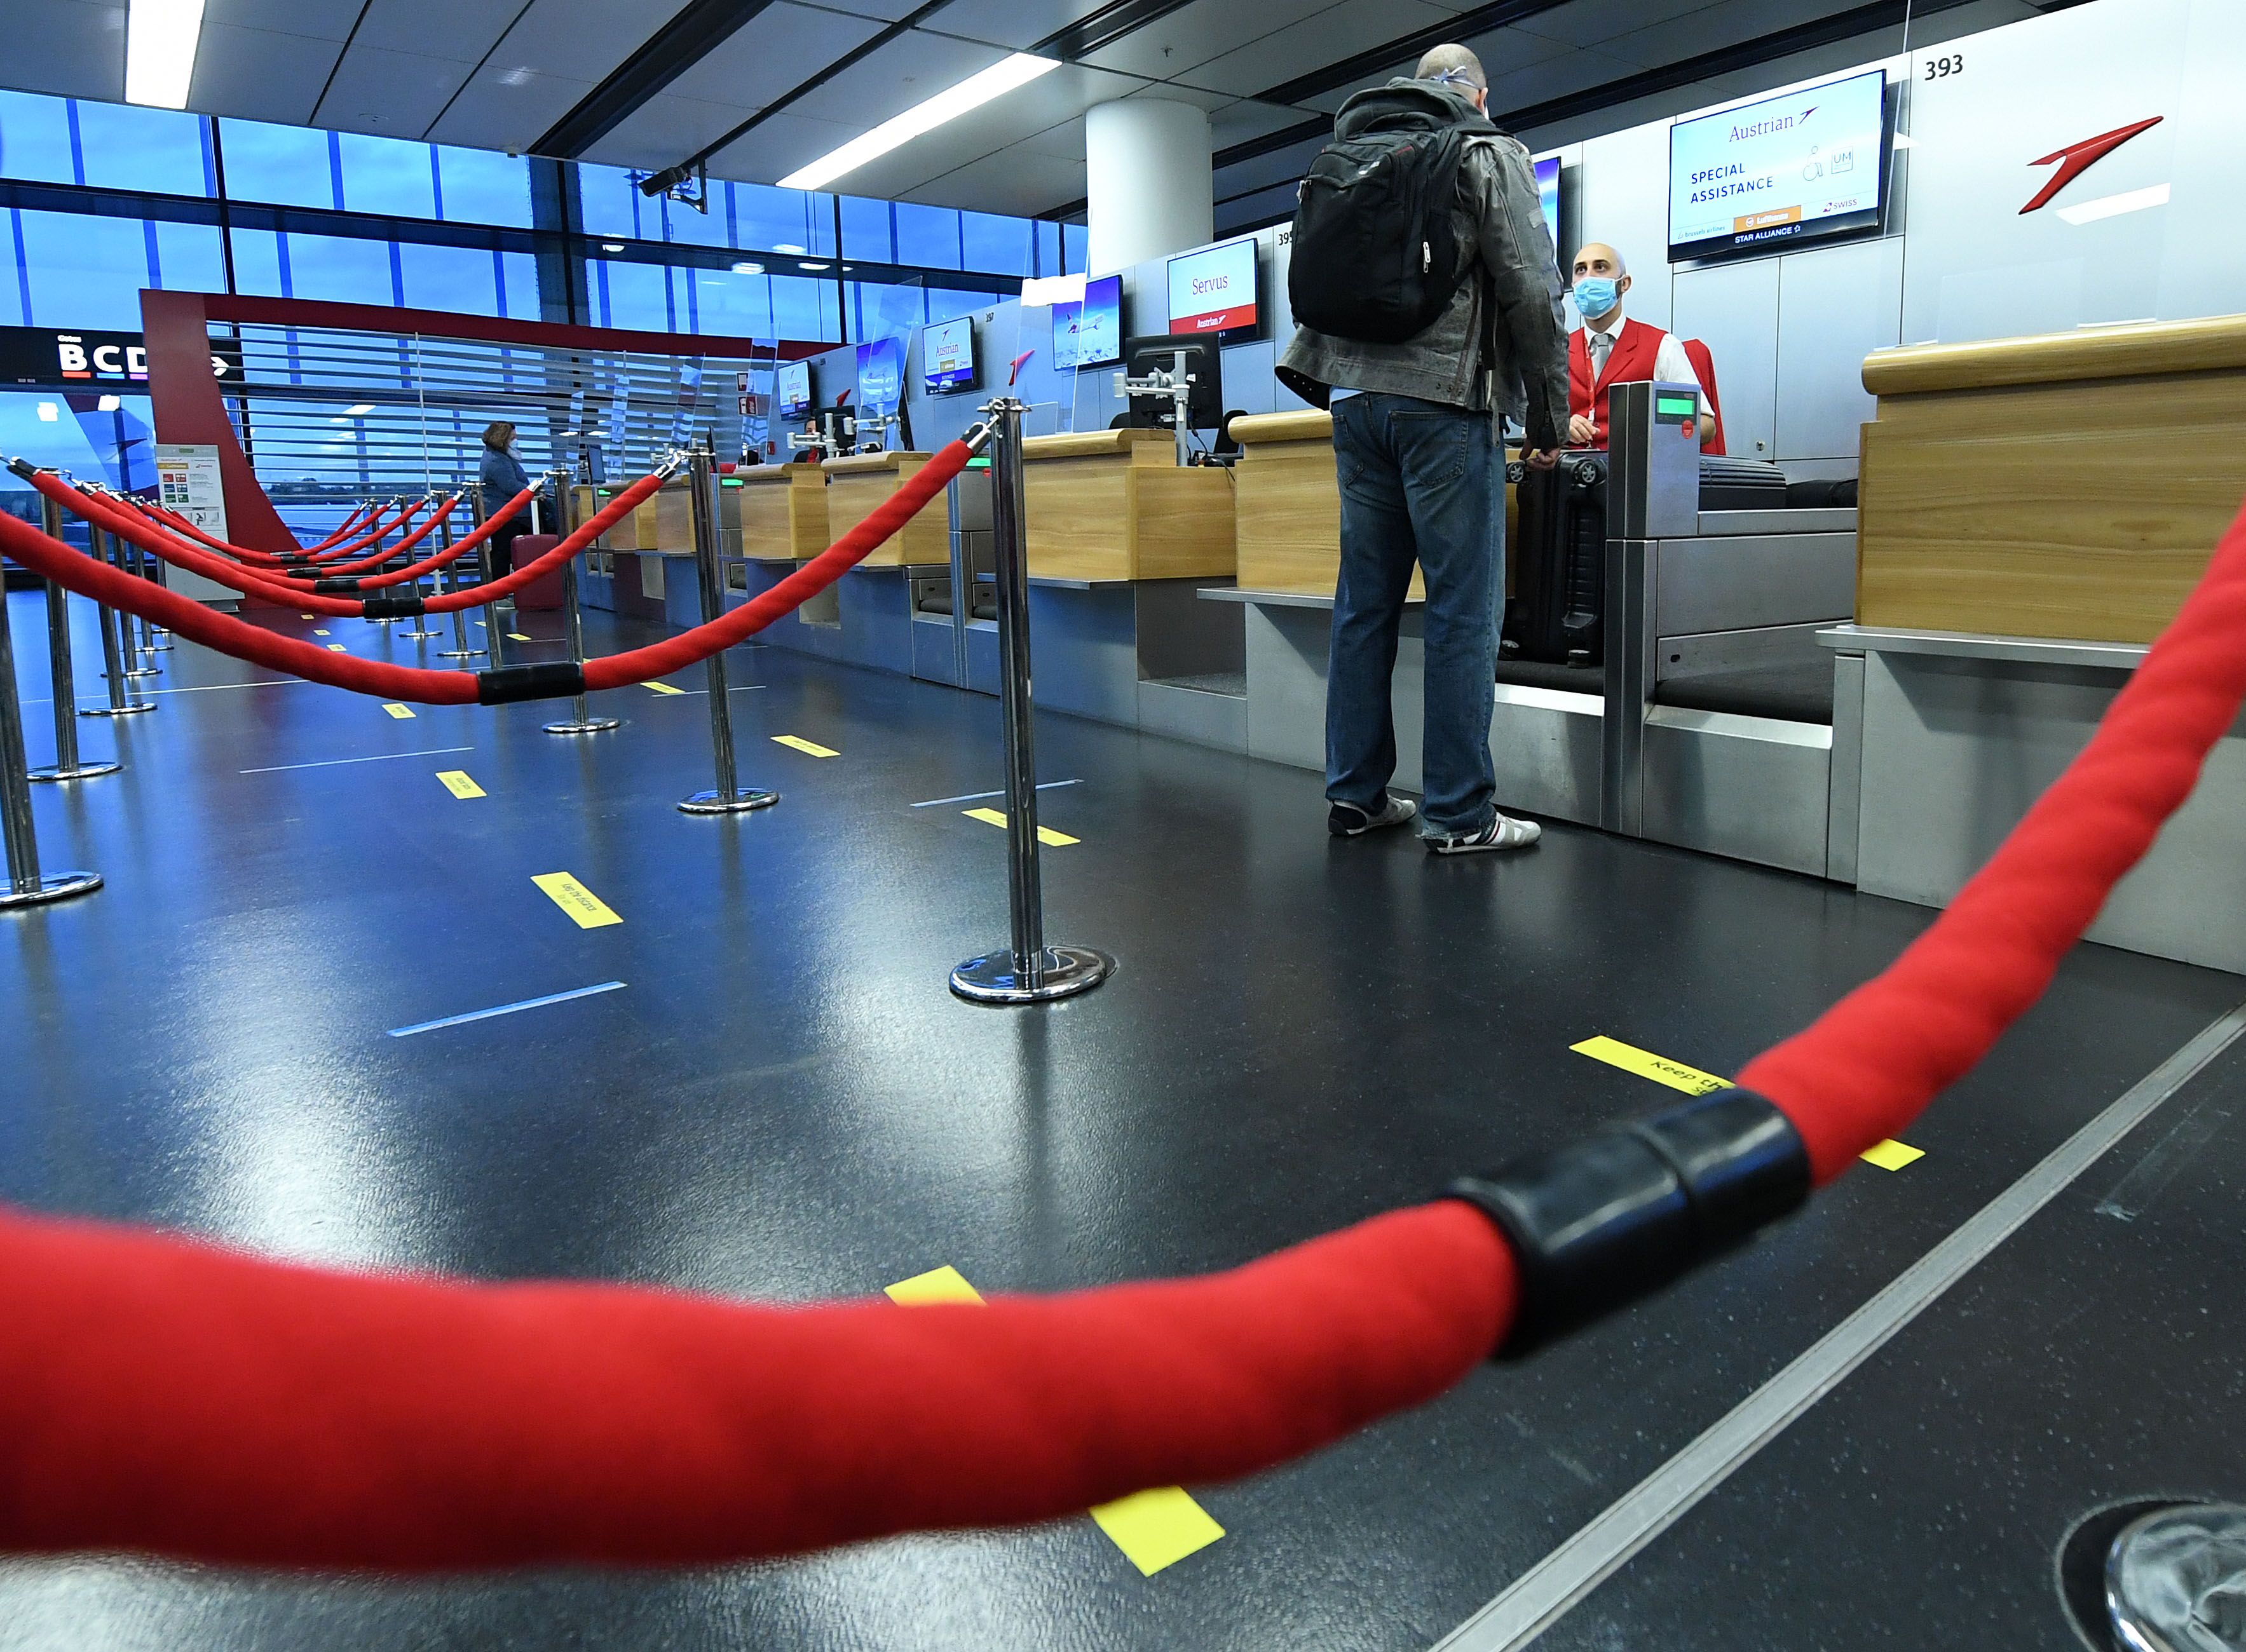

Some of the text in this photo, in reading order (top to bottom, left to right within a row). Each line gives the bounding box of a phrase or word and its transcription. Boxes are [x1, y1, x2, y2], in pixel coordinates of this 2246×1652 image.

[1925, 55, 1963, 81] 393
[1729, 116, 1793, 142] Austrian
[1834, 151, 1851, 163] UM
[1691, 163, 1746, 184] SPECIAL
[1691, 176, 1774, 204] ASSISTANCE
[1834, 199, 1857, 210] SWISS
[1685, 228, 1705, 238] brussels
[1734, 227, 1793, 243] STAR ALLIANCE
[1192, 275, 1228, 295] Servus
[1196, 316, 1218, 328] Austrian
[936, 342, 958, 357] Austrian
[1650, 1061, 1723, 1090] Keep th
